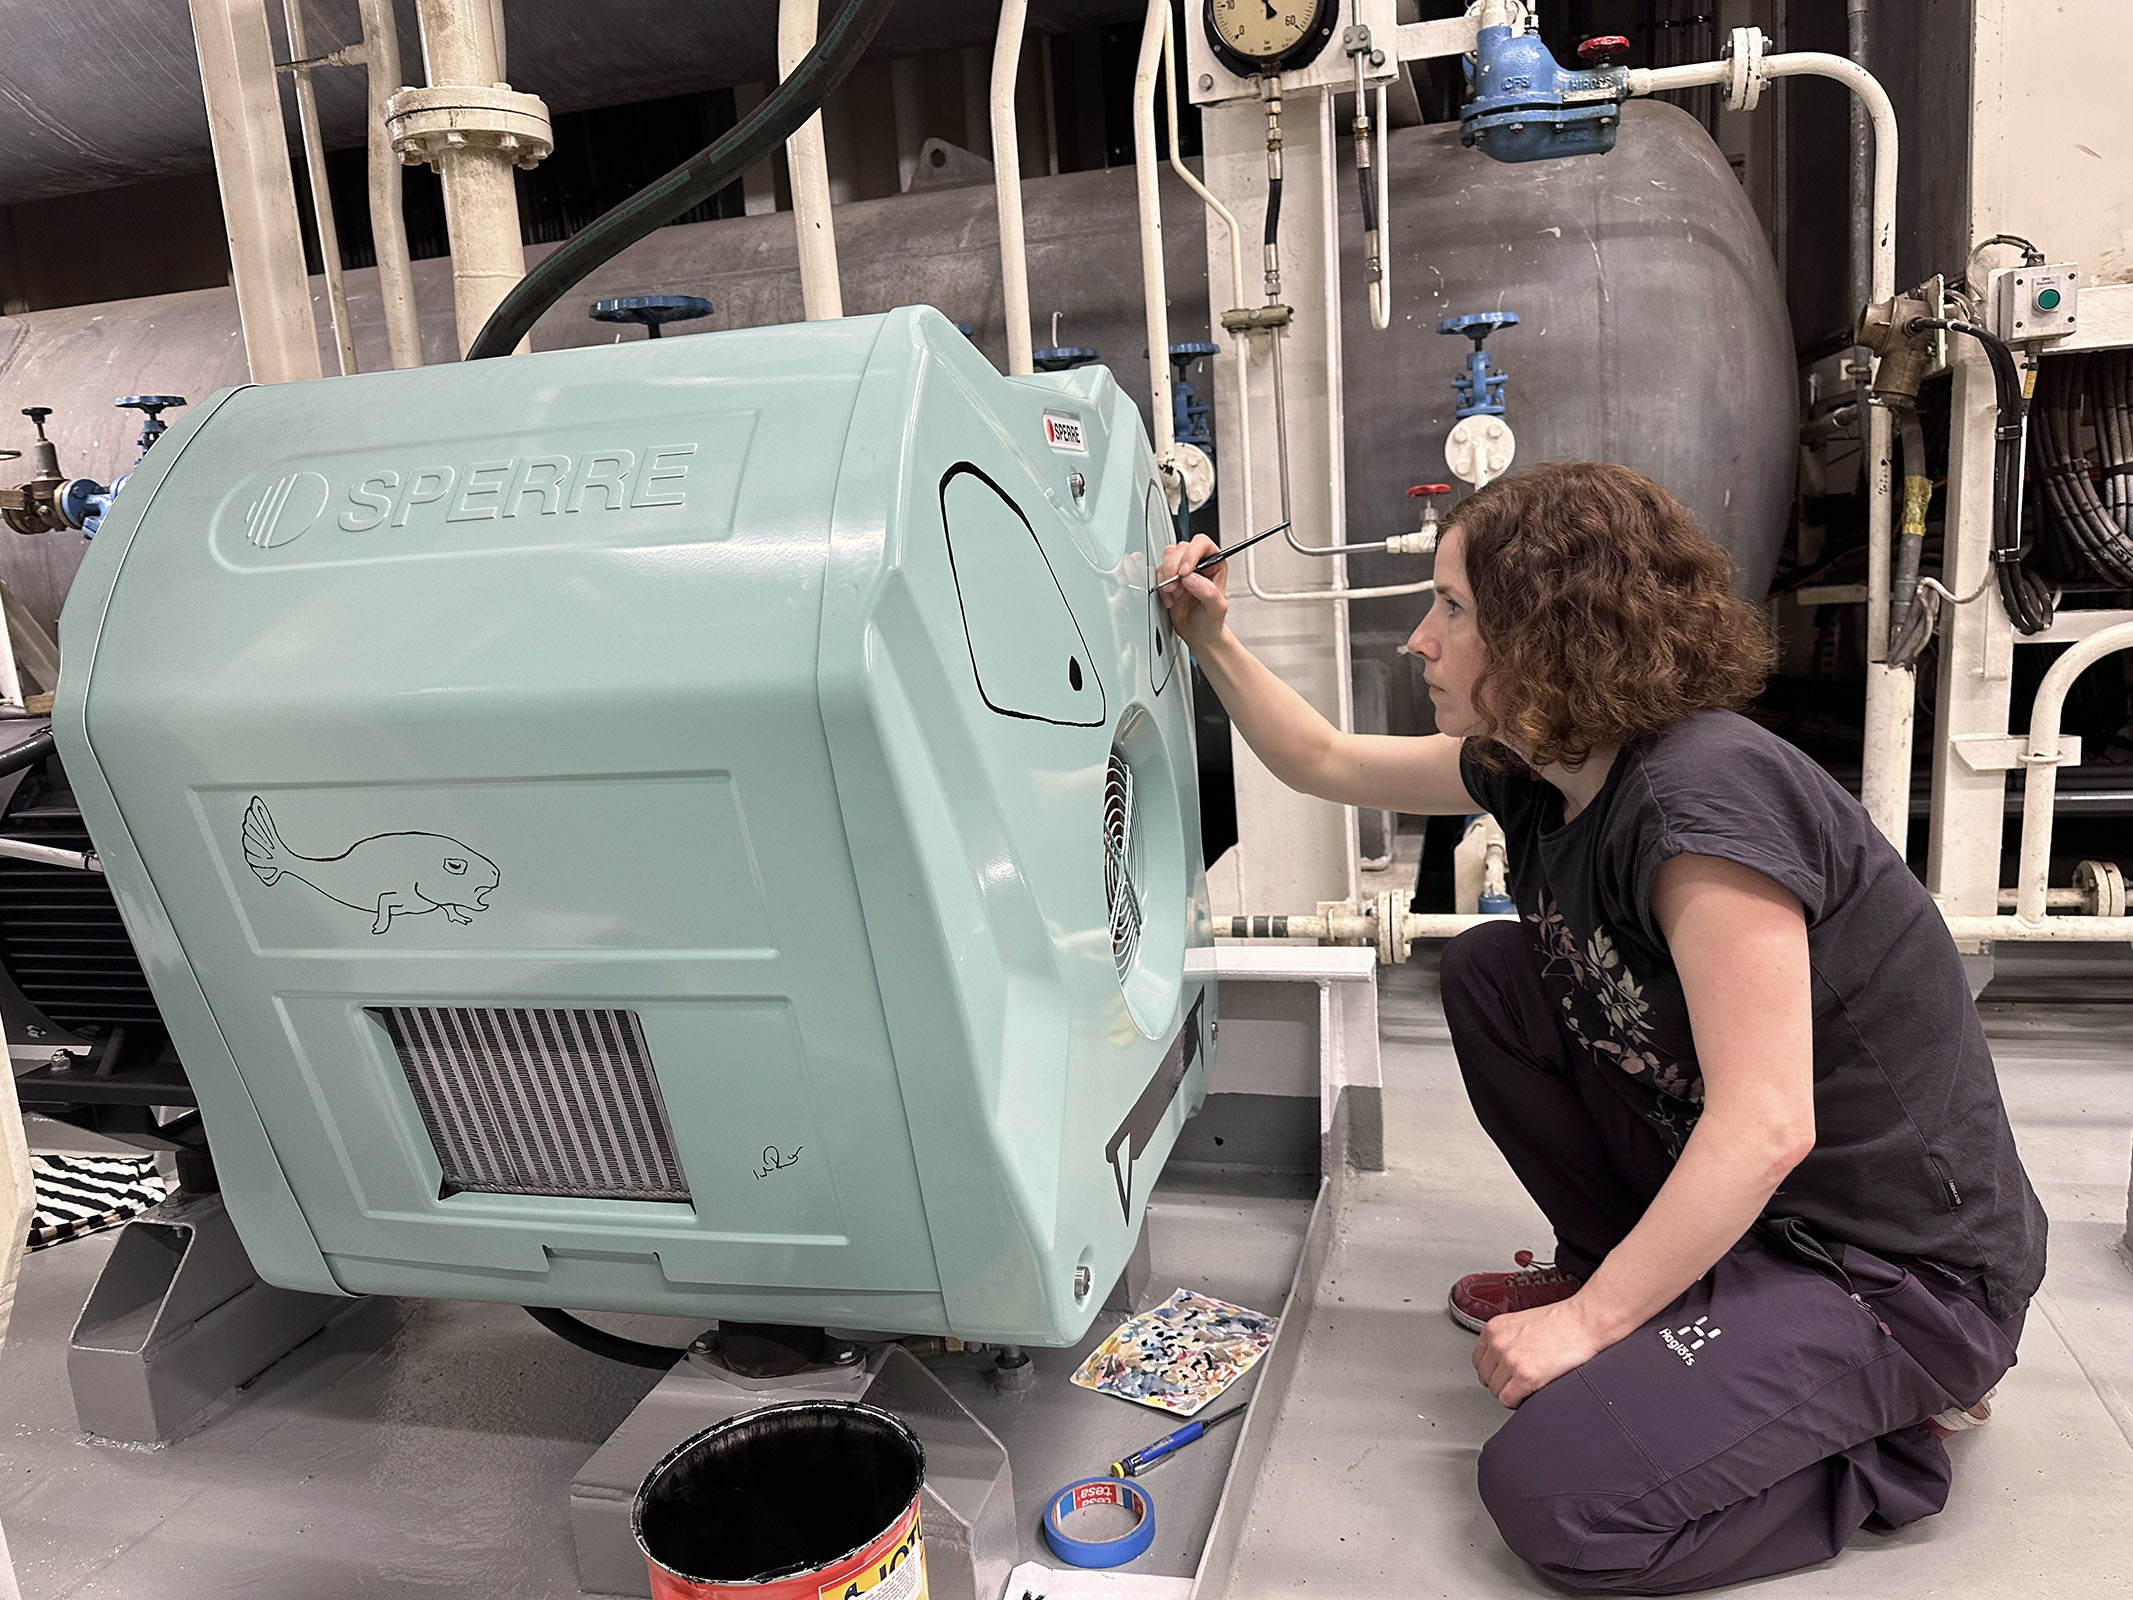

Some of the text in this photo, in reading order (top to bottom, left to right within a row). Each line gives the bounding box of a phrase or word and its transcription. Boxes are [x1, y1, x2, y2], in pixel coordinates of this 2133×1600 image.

[1226, 0, 1235, 10] 10
[1285, 15, 1297, 26] 60
[1239, 25, 1245, 35] 0
[1053, 422, 1081, 444] SPERRE
[338, 442, 698, 532] SPERRE
[1659, 1327, 1696, 1367] Haglöfs
[1080, 1485, 1113, 1499] tesa
